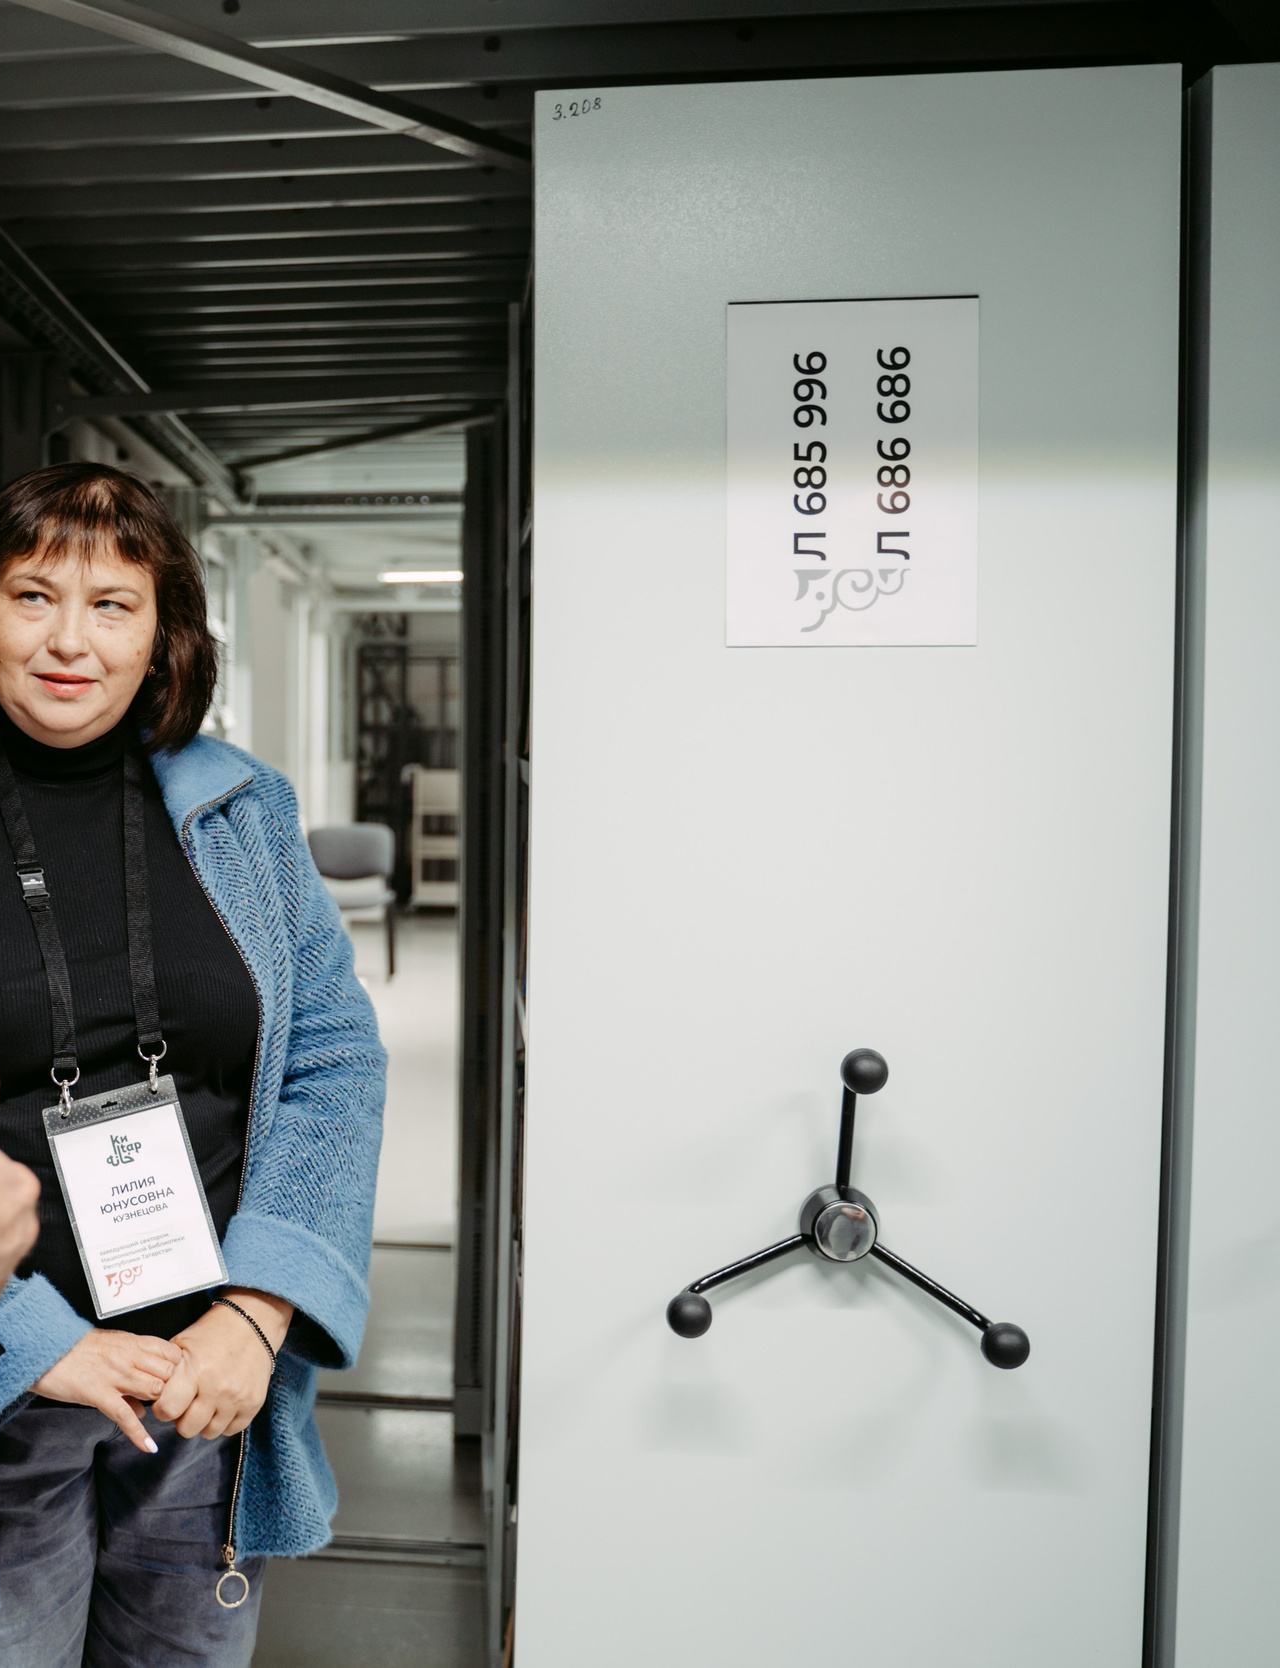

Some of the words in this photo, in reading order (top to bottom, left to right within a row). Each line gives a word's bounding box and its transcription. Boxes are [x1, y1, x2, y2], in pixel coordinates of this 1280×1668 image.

[552, 97, 602, 121] 3.208
[793, 351, 827, 428] 996
[876, 346, 911, 424] 686
[793, 440, 827, 516] 685
[876, 437, 911, 515] 686
[793, 532, 827, 561] Л
[876, 531, 911, 560] Л
[111, 1175, 156, 1197] ЛИЛИЯ
[100, 1187, 175, 1215] ЮНУСОВНА
[113, 1202, 169, 1224] КУЗНЕЦОВА
